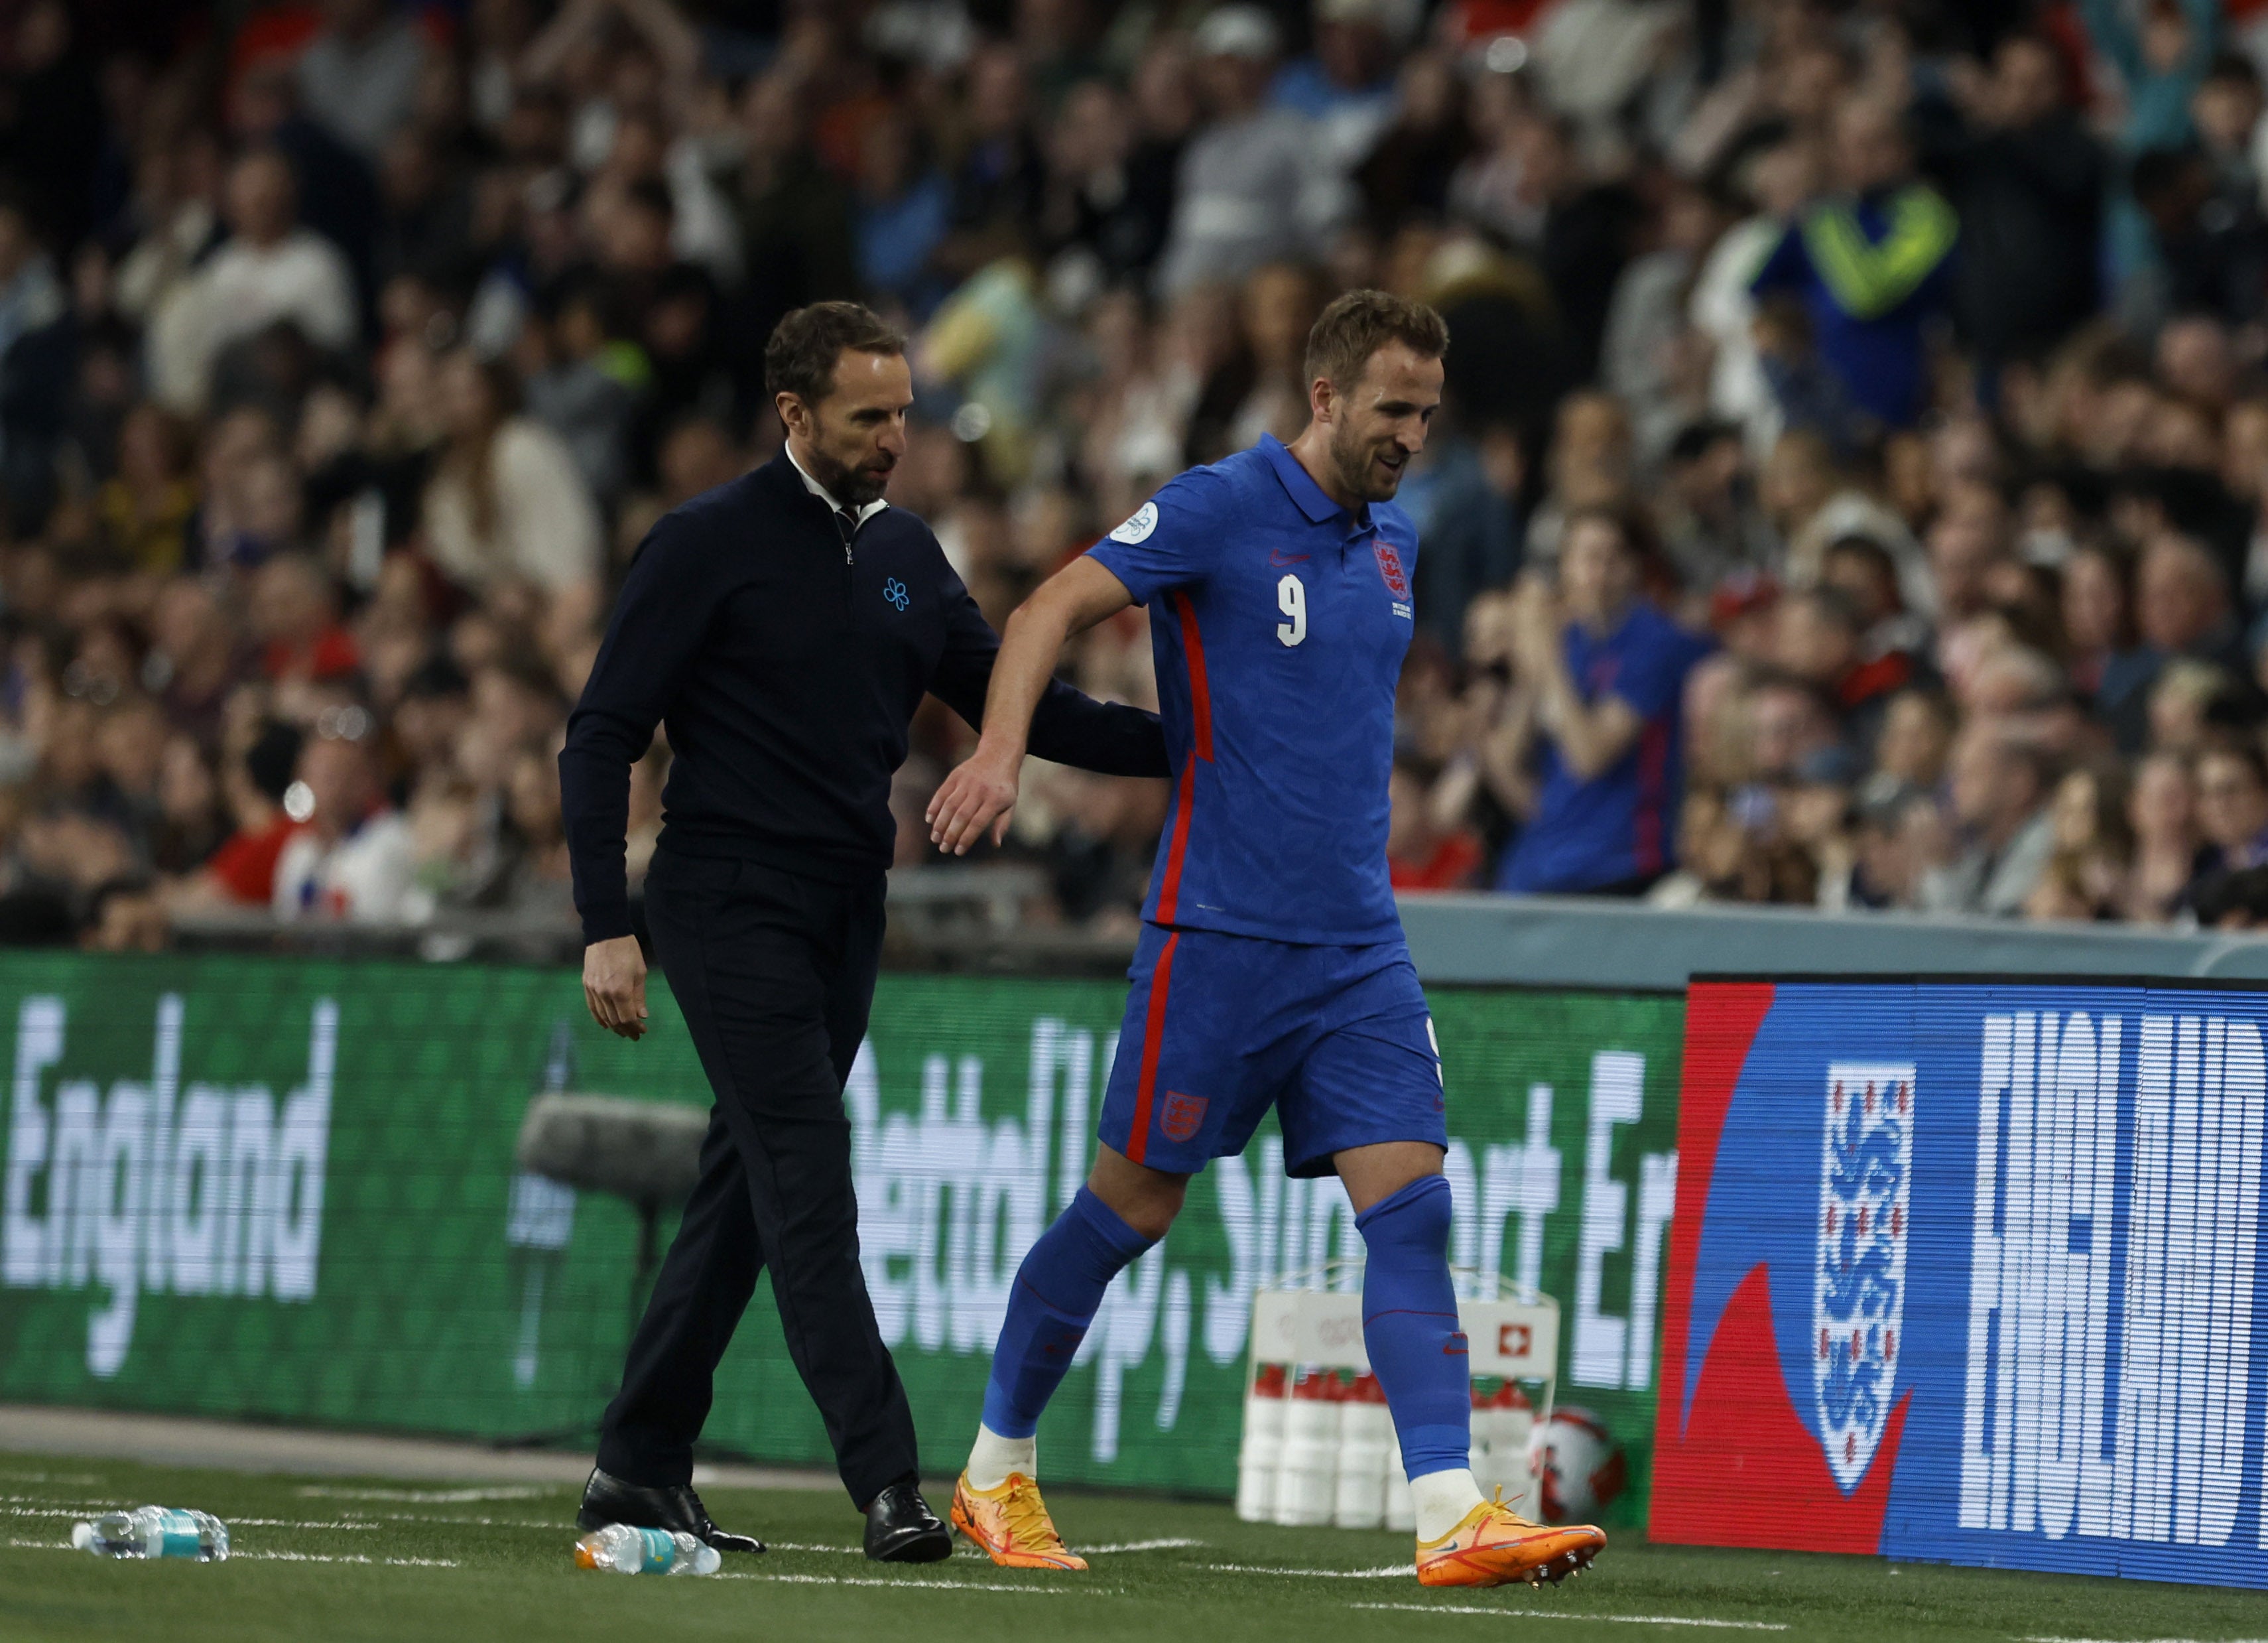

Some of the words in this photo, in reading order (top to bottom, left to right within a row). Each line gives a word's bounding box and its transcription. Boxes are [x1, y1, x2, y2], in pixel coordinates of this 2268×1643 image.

[1277, 574, 1307, 647] 9
[2, 991, 340, 1379] England
[1958, 1011, 2265, 1546] ENGLAND
